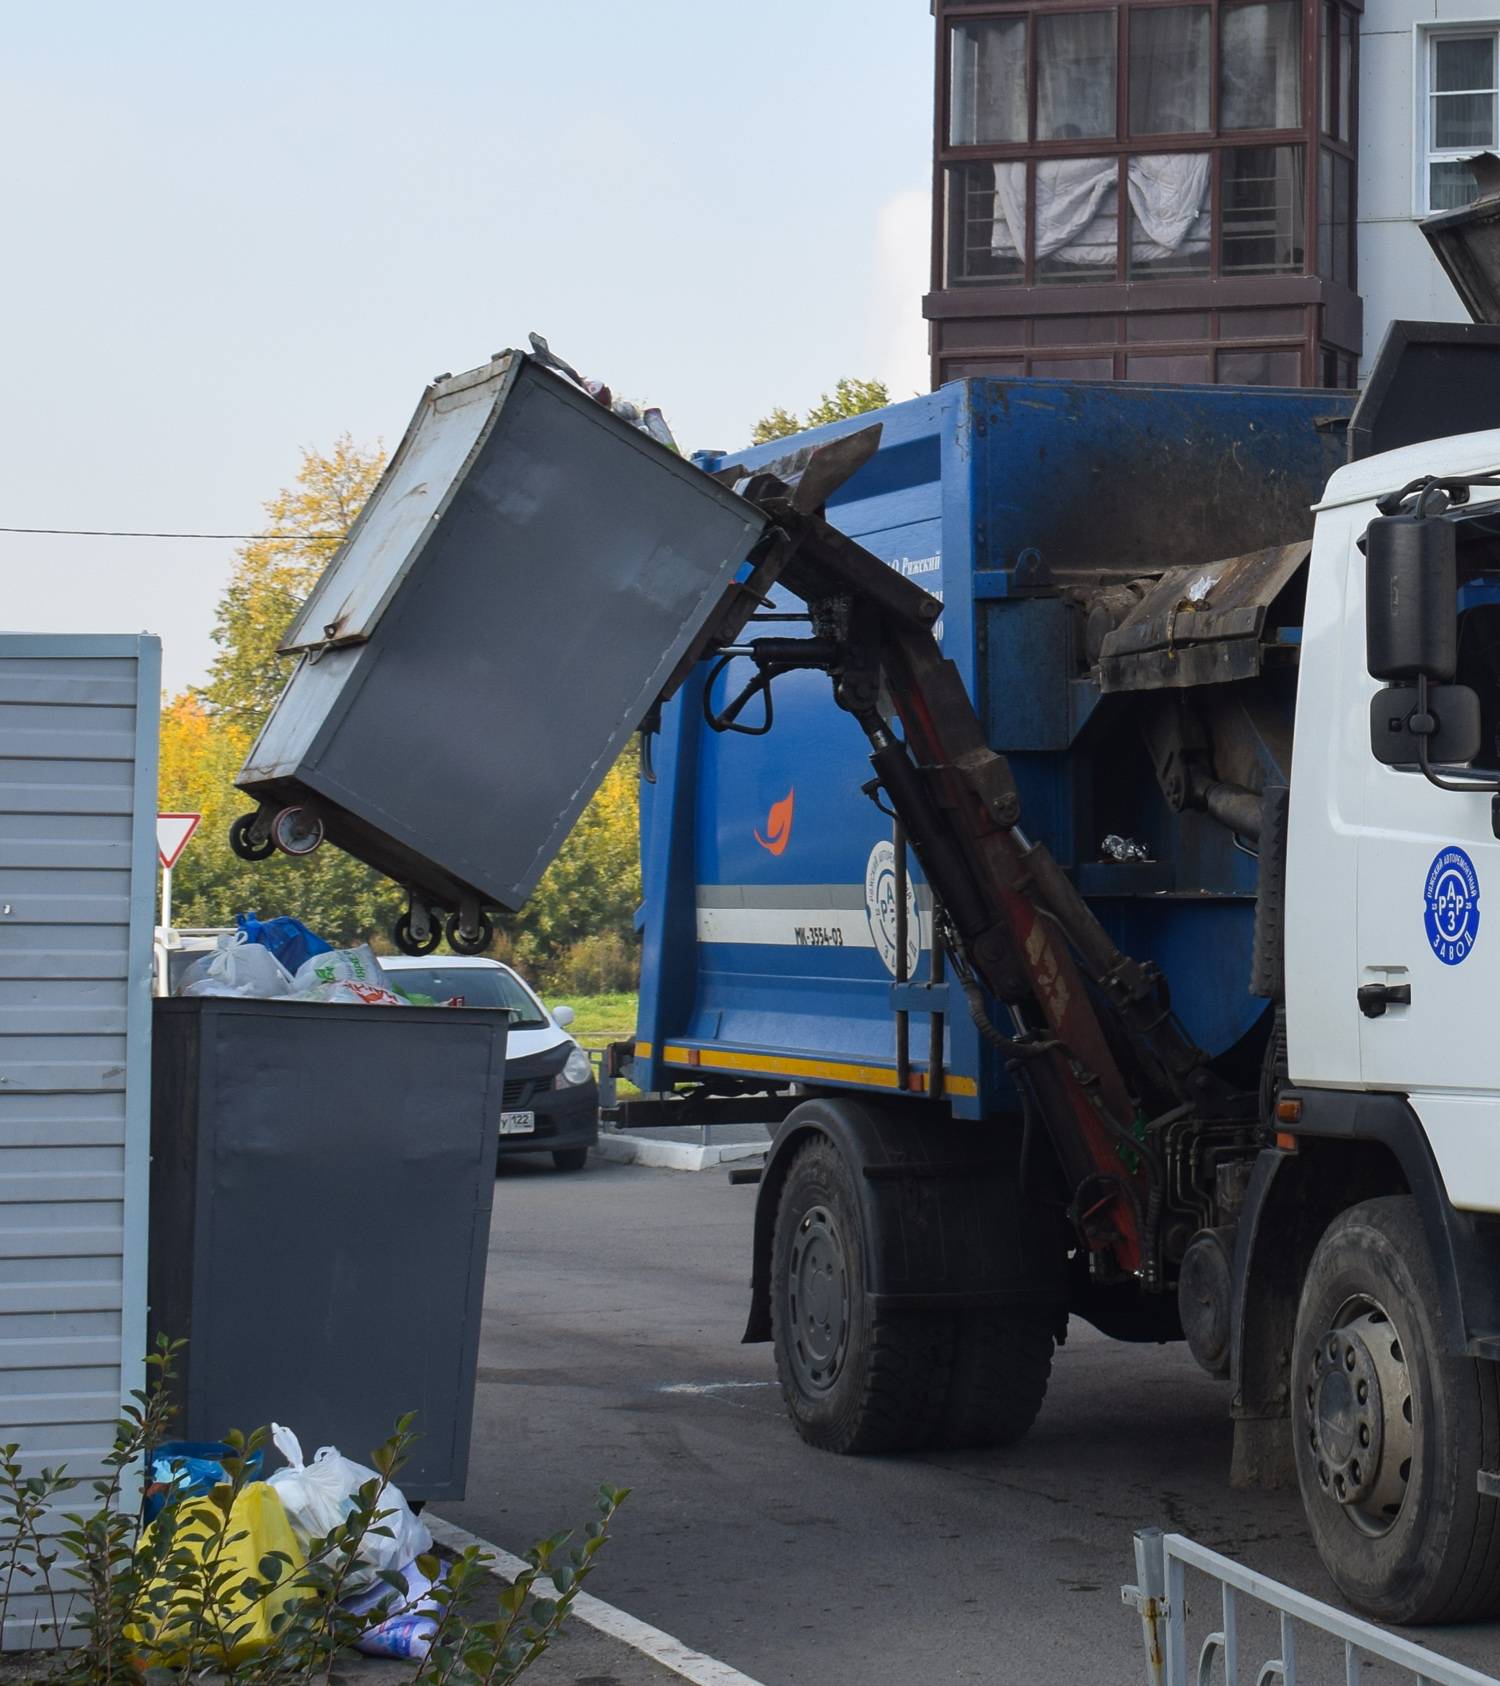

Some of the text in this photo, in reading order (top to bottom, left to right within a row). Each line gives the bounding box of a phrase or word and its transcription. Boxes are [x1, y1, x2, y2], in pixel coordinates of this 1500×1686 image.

[902, 551, 941, 576] Ряжский
[794, 926, 844, 945] МК-3554-03
[511, 1114, 529, 1125] 122
